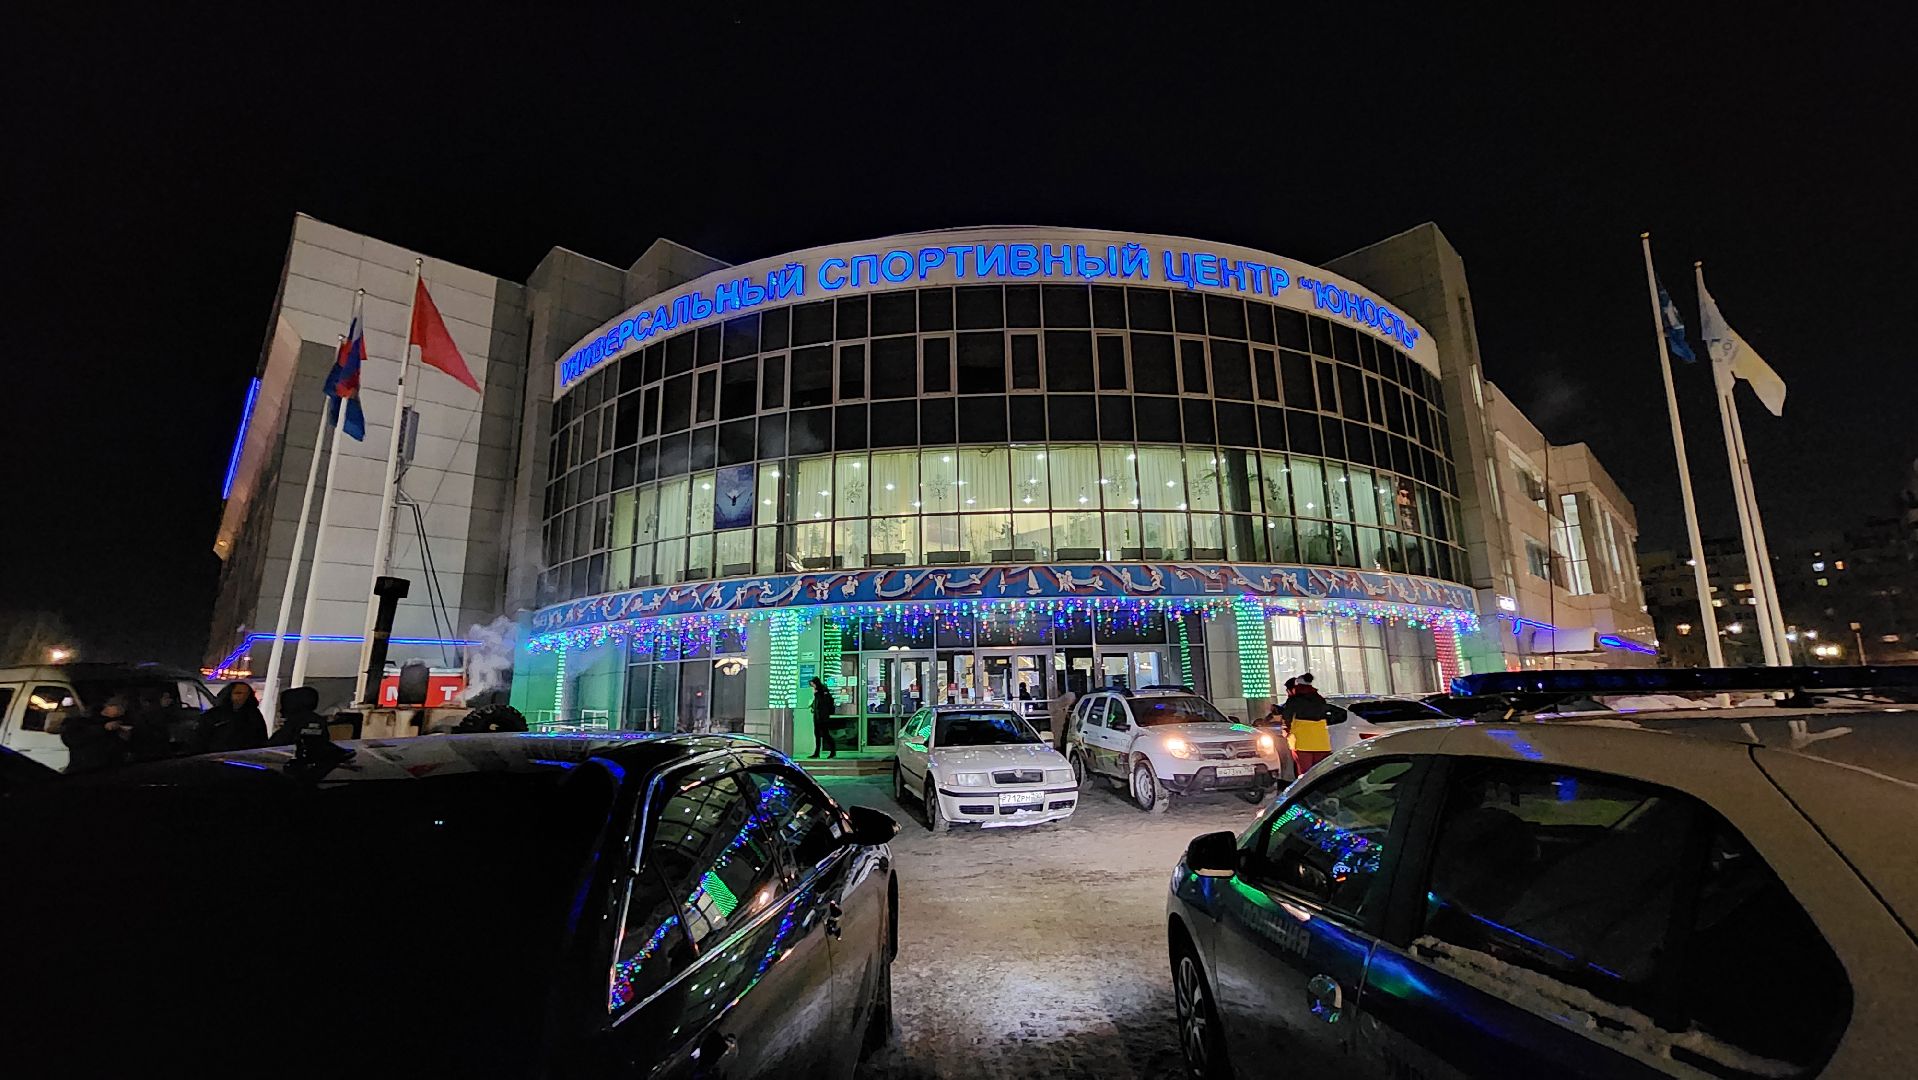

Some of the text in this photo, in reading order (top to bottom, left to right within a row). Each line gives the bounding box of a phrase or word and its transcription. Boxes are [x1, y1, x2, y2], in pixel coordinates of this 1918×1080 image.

[560, 263, 805, 386] УНИВЕРСАЛЬНЫЙ
[818, 243, 1150, 291] СПОРТИВНЫЙ
[1163, 250, 1290, 296] ЦЕНТР
